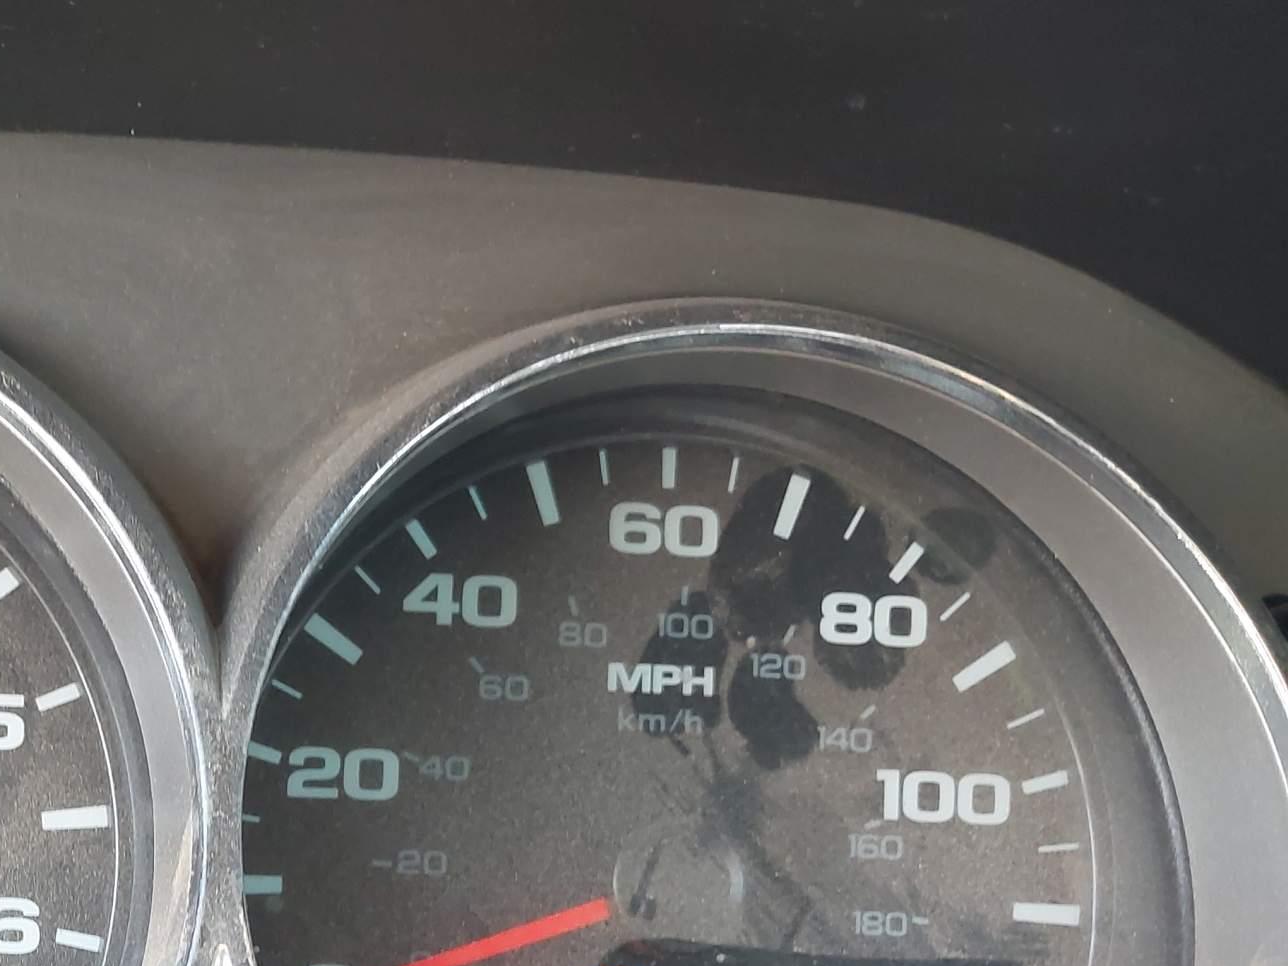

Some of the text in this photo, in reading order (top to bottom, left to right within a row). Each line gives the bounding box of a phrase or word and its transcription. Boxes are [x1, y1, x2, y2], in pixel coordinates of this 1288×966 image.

[609, 502, 719, 558] 60
[402, 573, 518, 628] 40
[658, 612, 714, 640] 100
[819, 592, 928, 648] 80
[558, 622, 608, 648] 80
[607, 662, 716, 697] MPH
[751, 655, 806, 680] 120
[478, 674, 530, 701] 60
[617, 710, 704, 736] km/h
[817, 727, 873, 753] 140
[286, 746, 400, 801] 20
[418, 755, 470, 781] 40
[876, 769, 1011, 825] 100
[848, 834, 903, 861] 160
[397, 850, 448, 875] 20
[854, 911, 908, 937] 180
